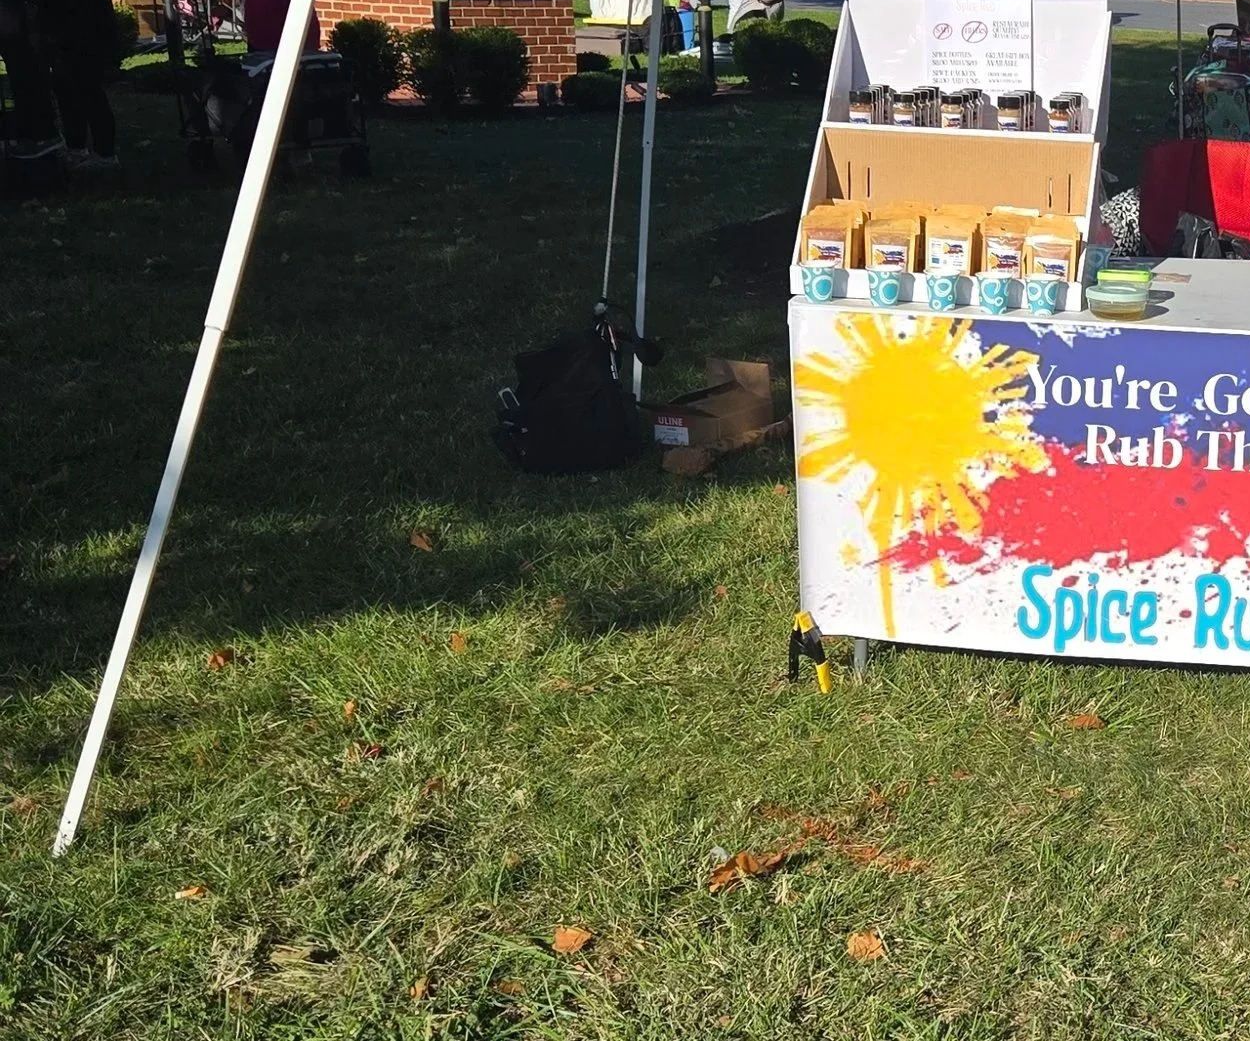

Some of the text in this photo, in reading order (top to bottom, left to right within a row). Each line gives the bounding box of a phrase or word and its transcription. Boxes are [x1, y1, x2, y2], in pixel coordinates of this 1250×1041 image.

[1025, 363, 1178, 411] You're
[657, 416, 683, 426] ULINE
[1085, 423, 1183, 469] Rub
[1017, 564, 1158, 653] Spice
